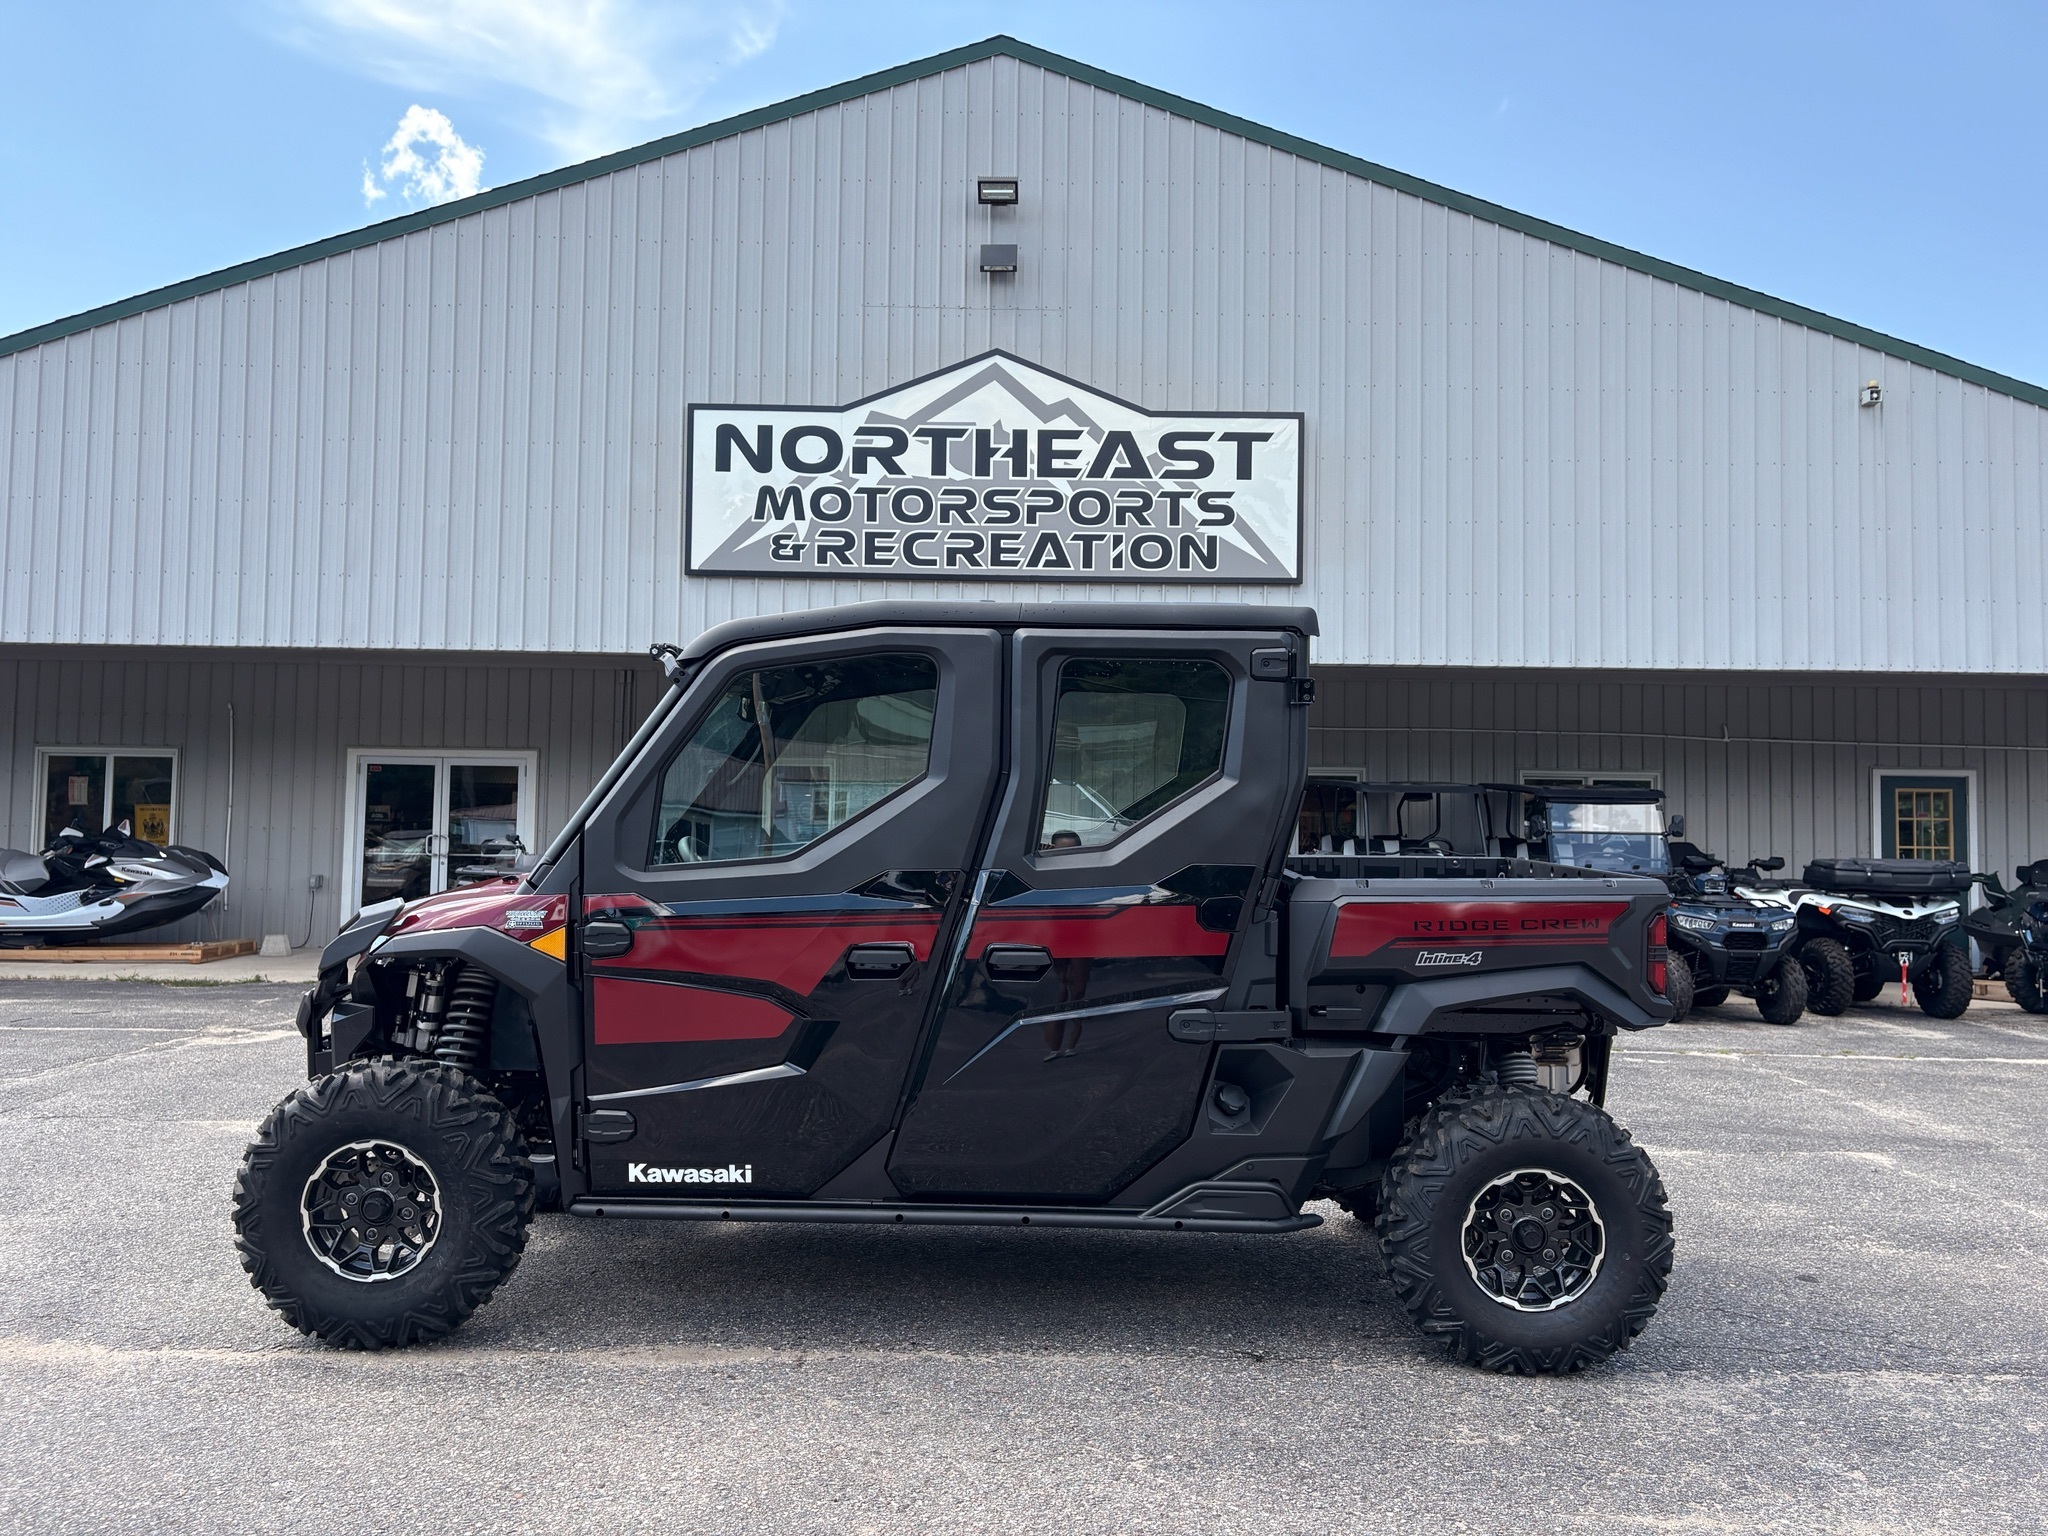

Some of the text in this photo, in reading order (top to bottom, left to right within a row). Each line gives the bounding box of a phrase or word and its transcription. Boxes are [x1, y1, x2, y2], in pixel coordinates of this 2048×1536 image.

[715, 423, 1275, 481] NORTHEAST
[754, 485, 1236, 527] MOTORSPORTS
[121, 866, 154, 877] Kawasaki
[1413, 918, 1600, 932] RIDGE CREW
[1415, 951, 1483, 966] Inline-4
[627, 1163, 752, 1183] Kawasaki
